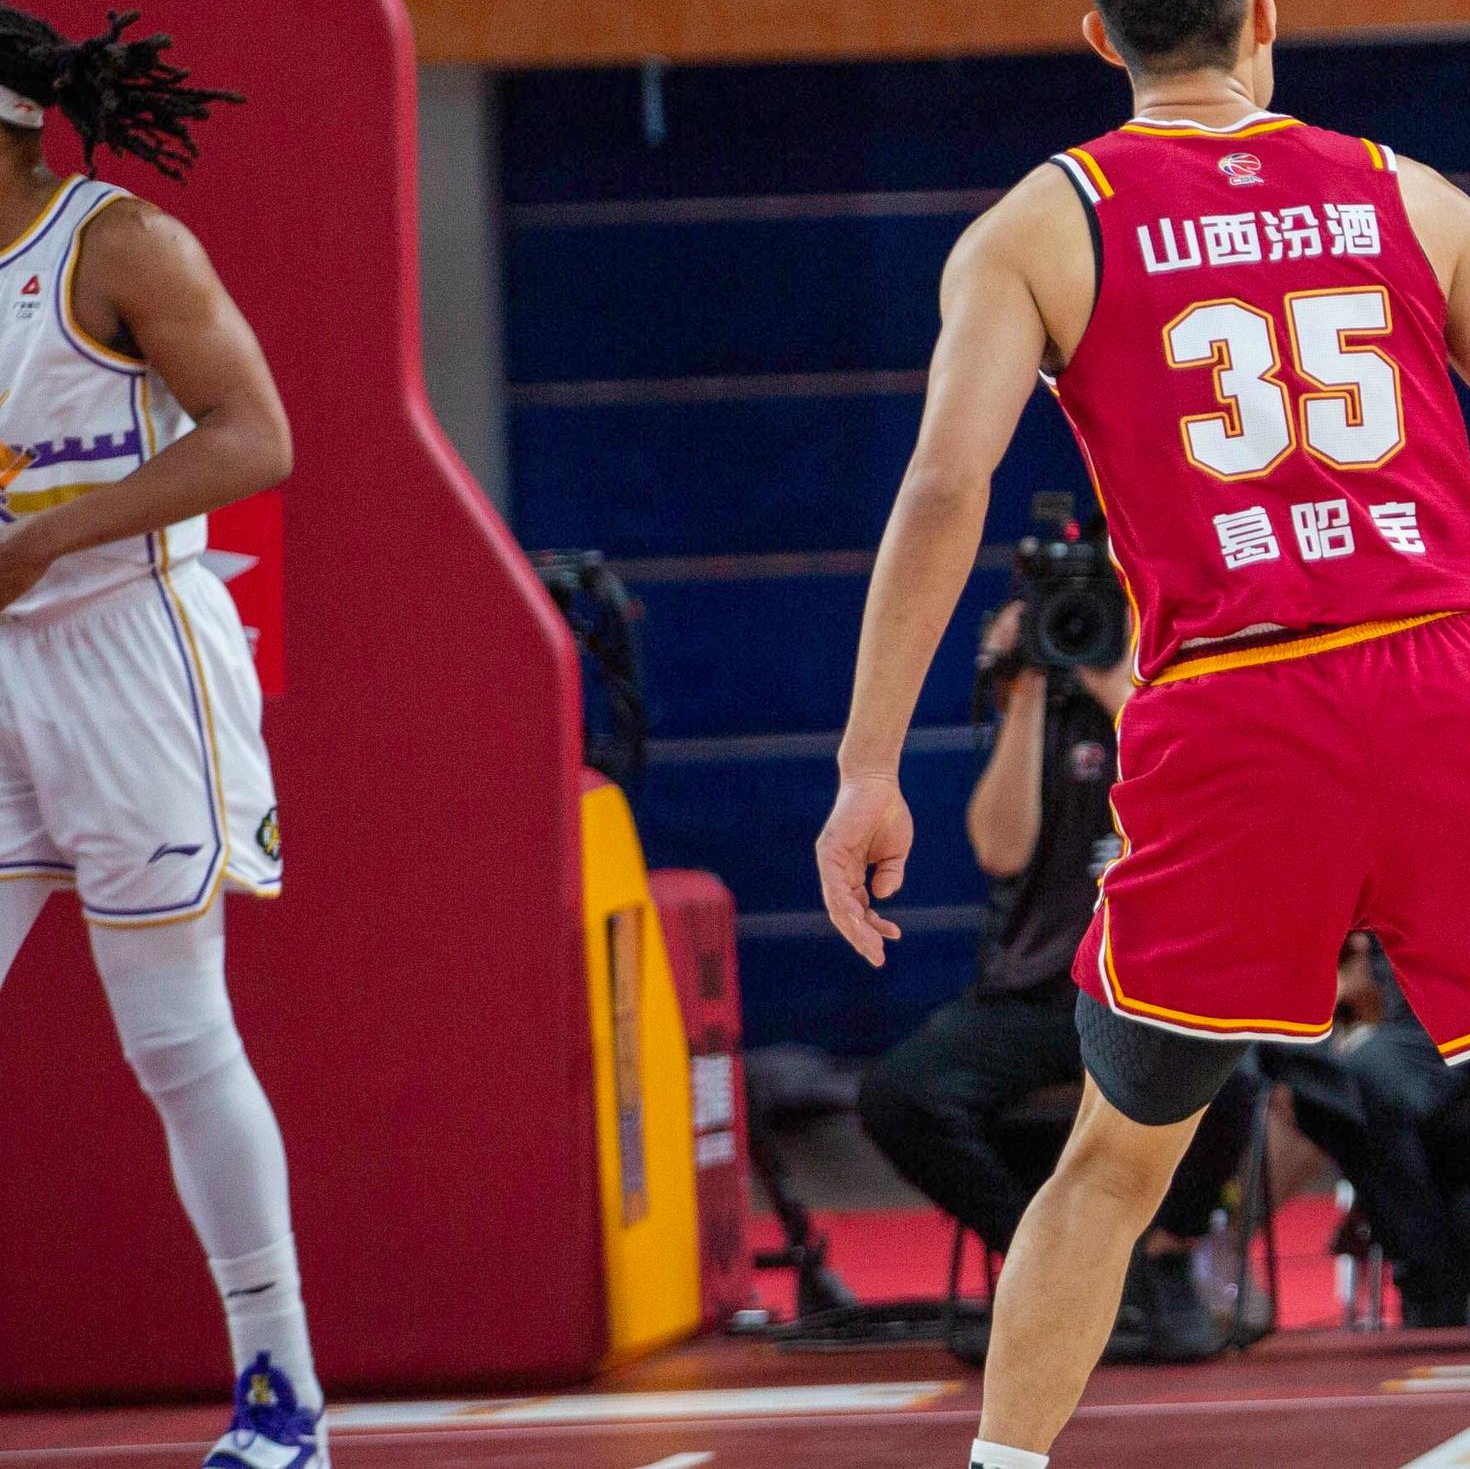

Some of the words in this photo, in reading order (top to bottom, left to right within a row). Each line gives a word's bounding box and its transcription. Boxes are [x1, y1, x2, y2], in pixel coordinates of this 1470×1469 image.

[1136, 202, 1382, 273] 山西汾酒
[1163, 285, 1405, 482] 35
[1212, 497, 1427, 571] 葛昭宝
